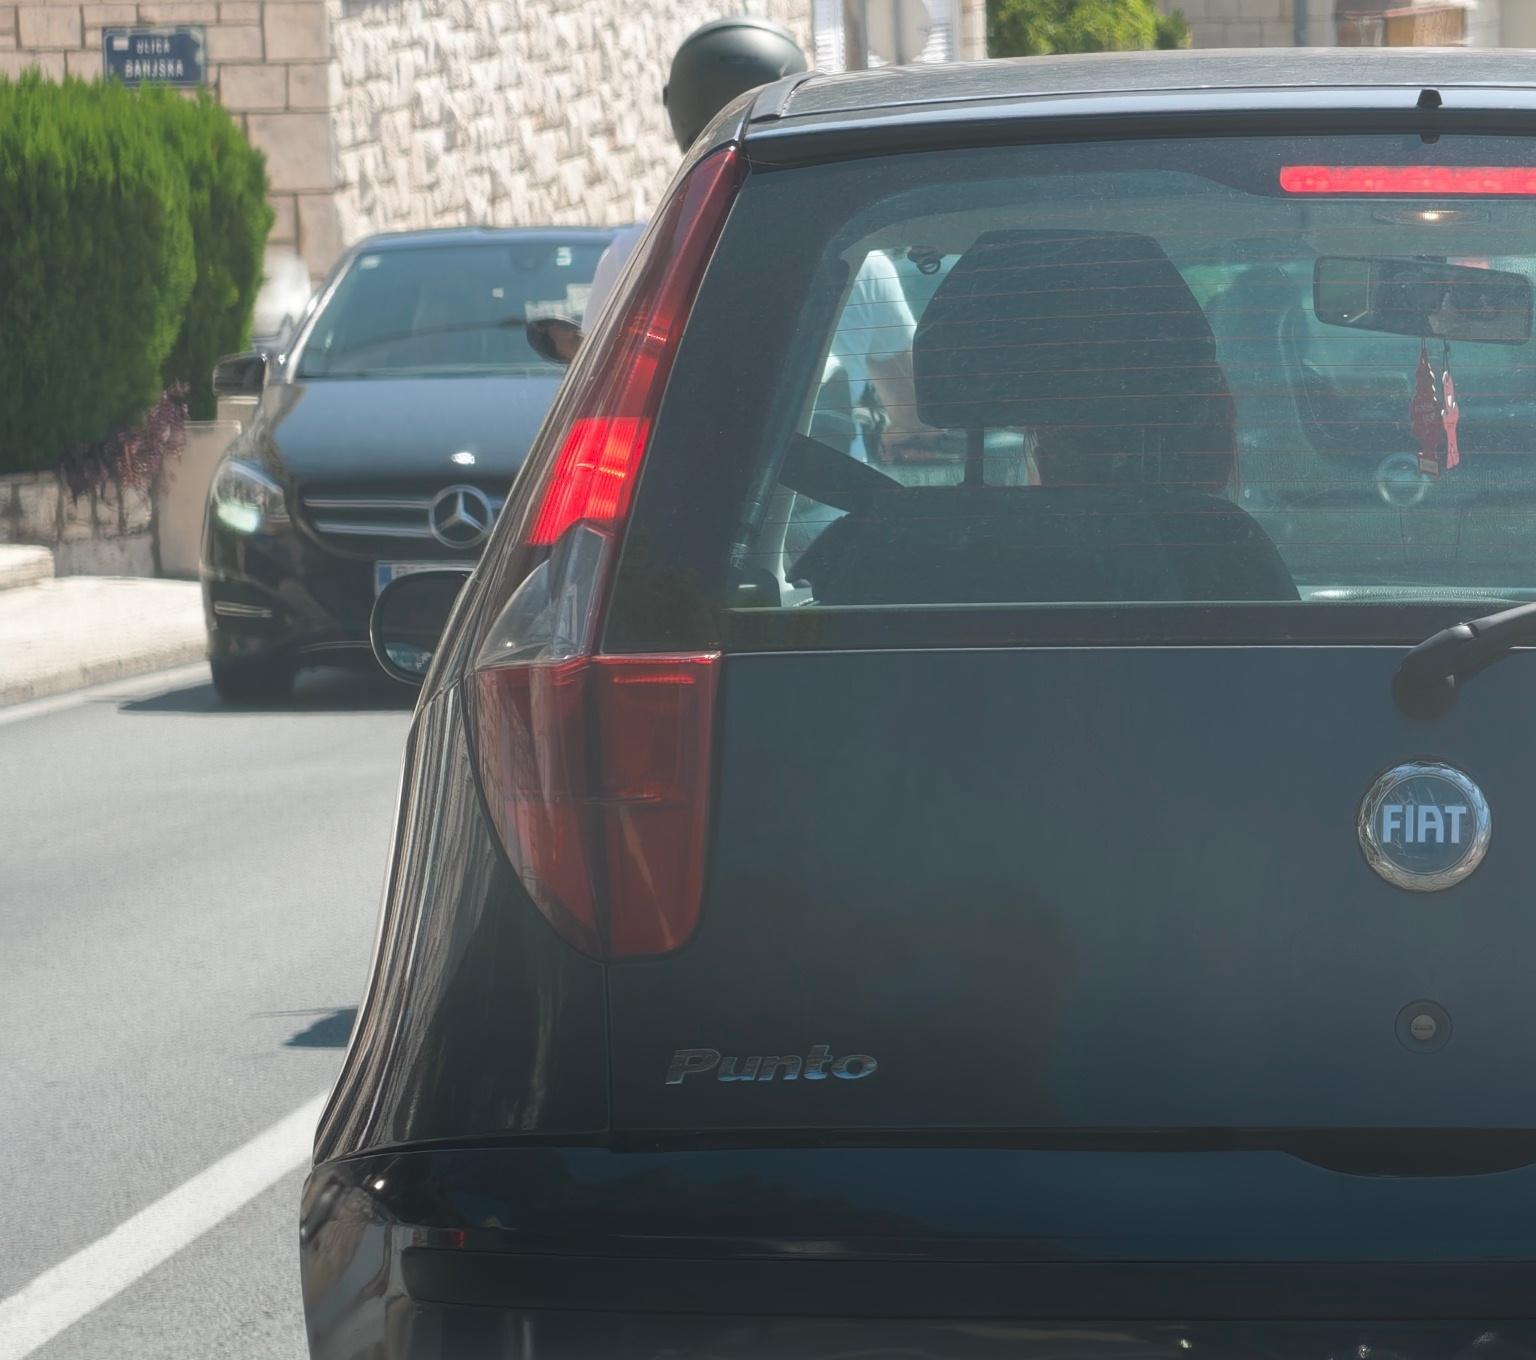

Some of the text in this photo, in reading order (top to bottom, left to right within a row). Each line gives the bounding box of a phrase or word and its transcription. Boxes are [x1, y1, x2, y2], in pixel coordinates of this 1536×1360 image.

[136, 40, 171, 54] ULICA
[1382, 804, 1467, 843] FIAT
[665, 1045, 878, 1085] Punto
